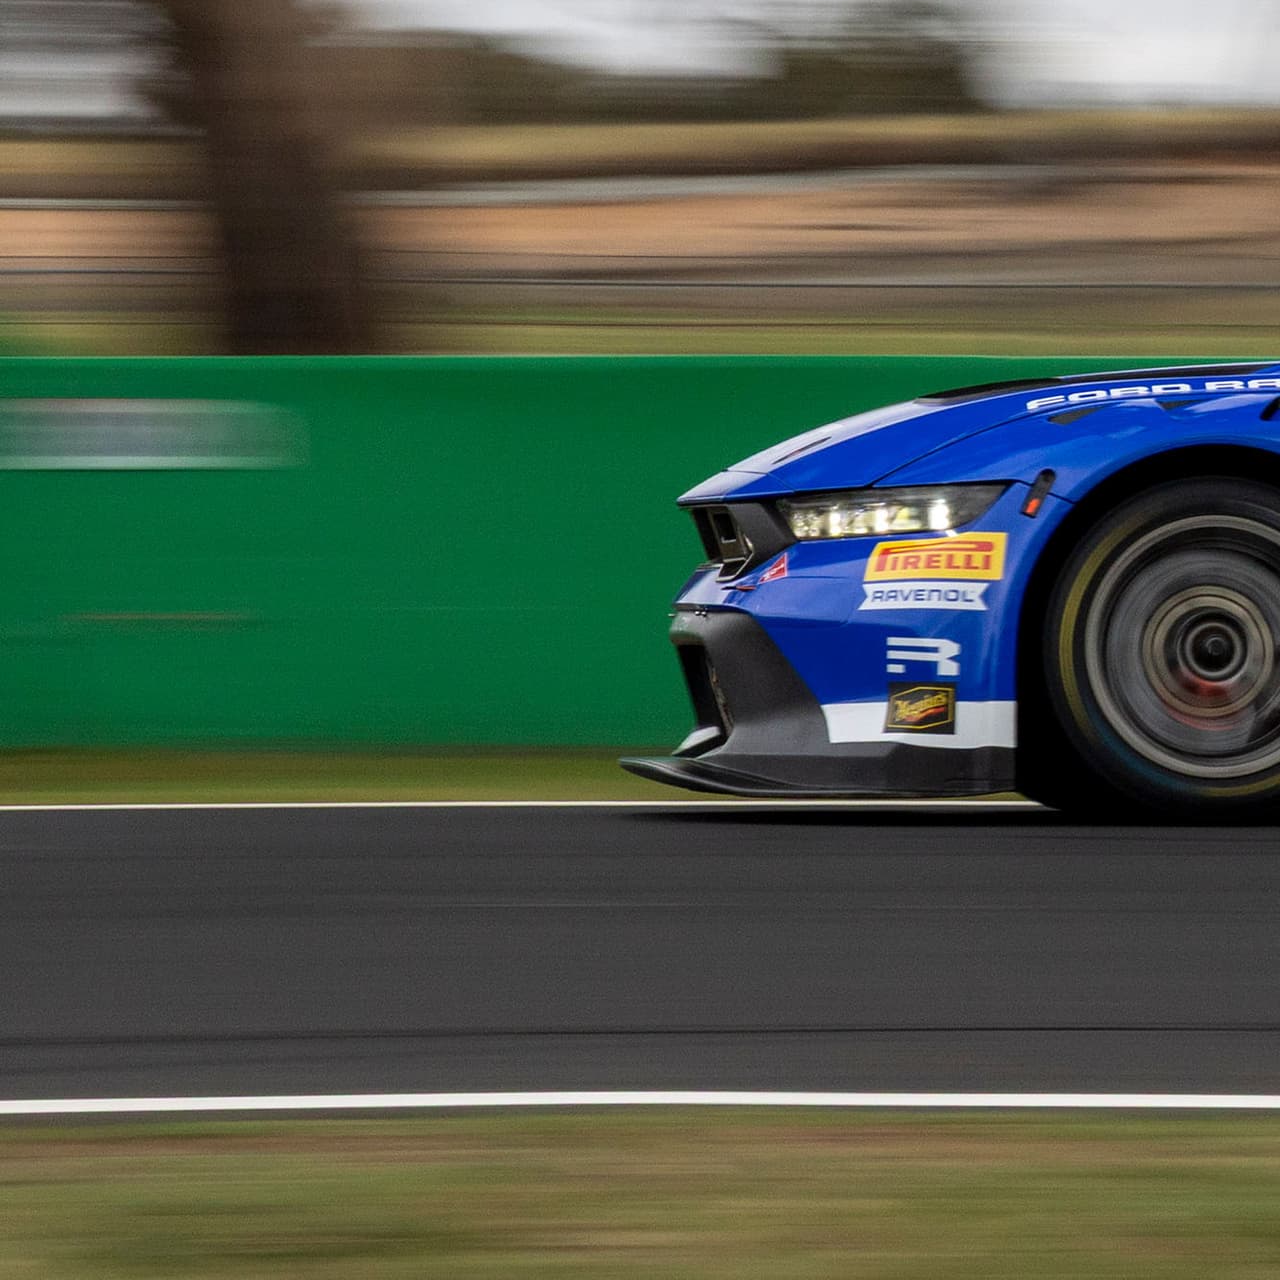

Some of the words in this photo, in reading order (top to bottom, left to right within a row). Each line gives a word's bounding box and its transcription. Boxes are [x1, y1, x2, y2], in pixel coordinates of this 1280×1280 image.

[1026, 384, 1191, 411] FORD
[874, 540, 995, 573] PIRELLI
[871, 588, 976, 603] RAVENOL
